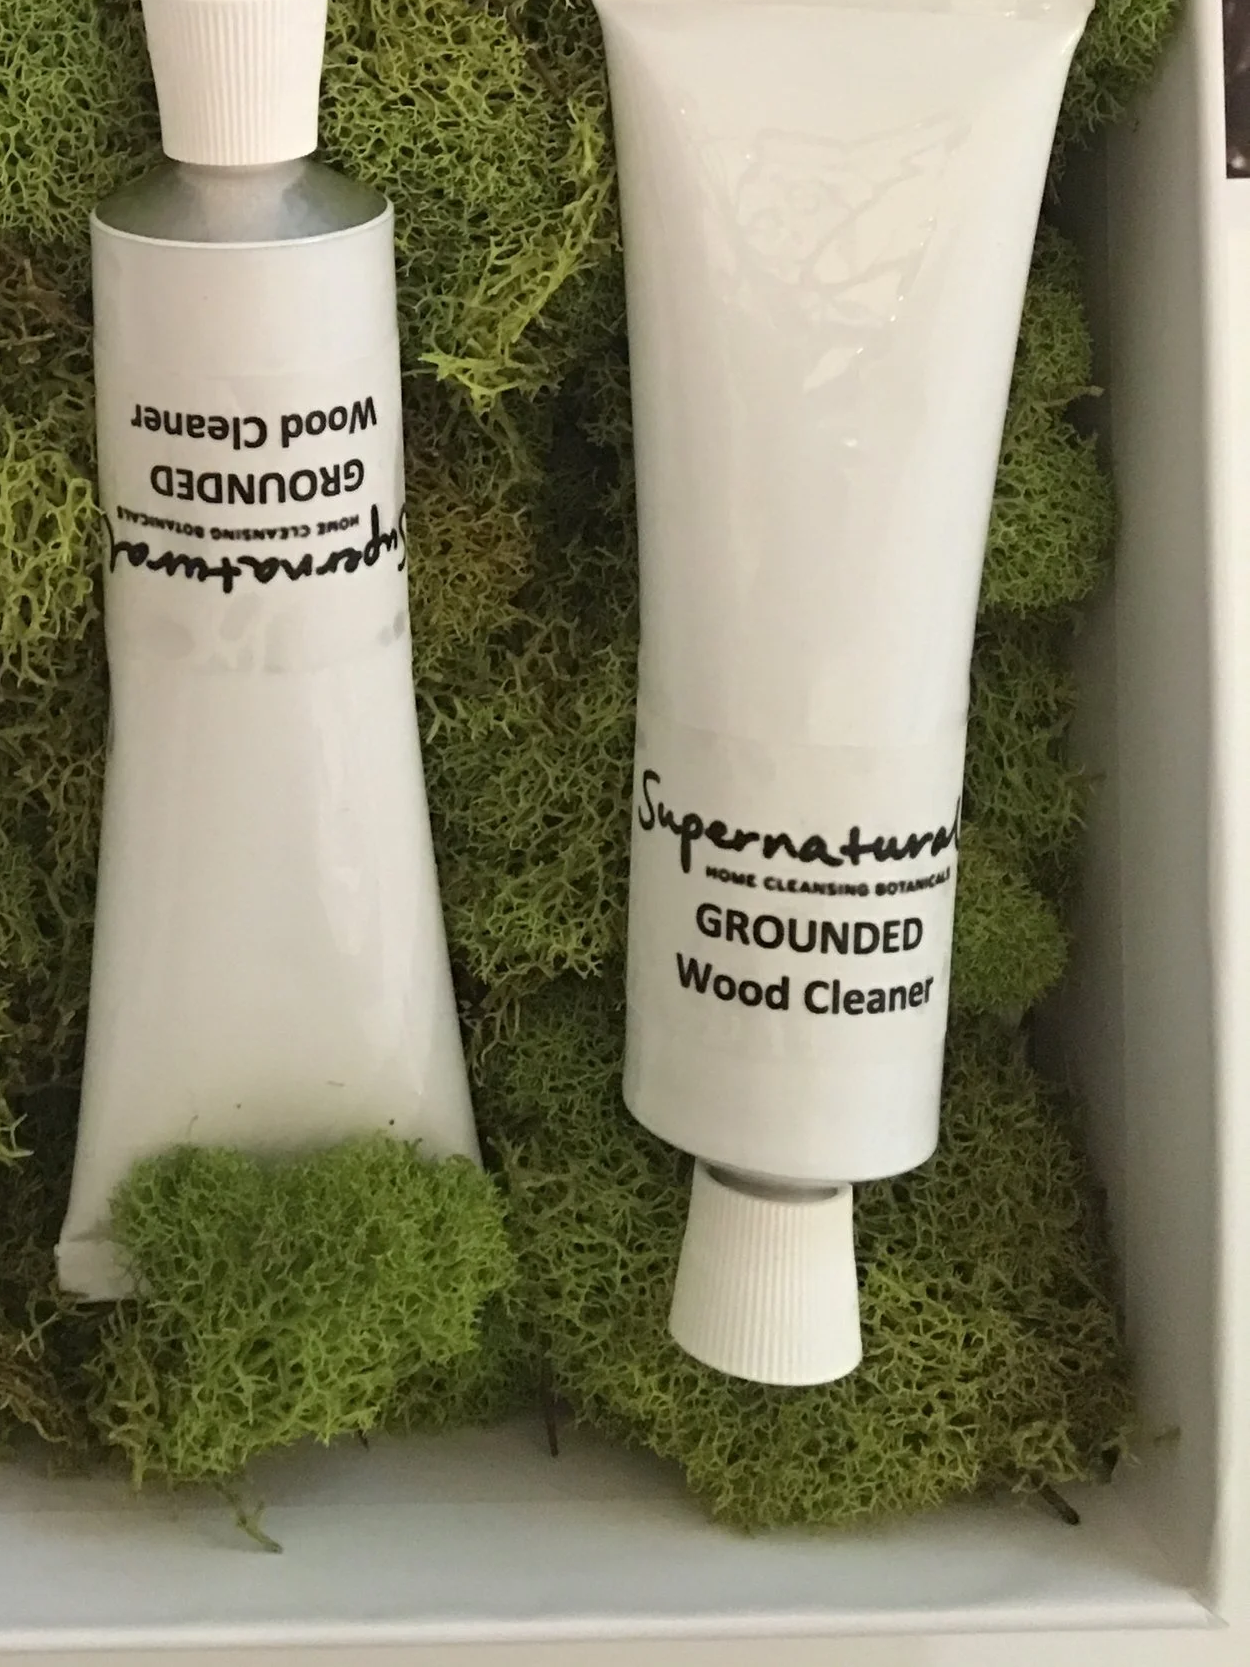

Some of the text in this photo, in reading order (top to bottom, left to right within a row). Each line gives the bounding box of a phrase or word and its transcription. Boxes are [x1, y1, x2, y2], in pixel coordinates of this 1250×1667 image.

[131, 396, 377, 450] Wood Cleaner
[150, 458, 365, 505] GROUNDED
[208, 525, 311, 542] CLEANSING
[316, 514, 359, 536] HOME
[637, 768, 961, 874] Supernatural
[705, 865, 757, 888] HOME
[762, 876, 870, 897] CLEANSING
[696, 902, 923, 955] GROUNDED
[675, 952, 934, 1016] Wood Cleaner
